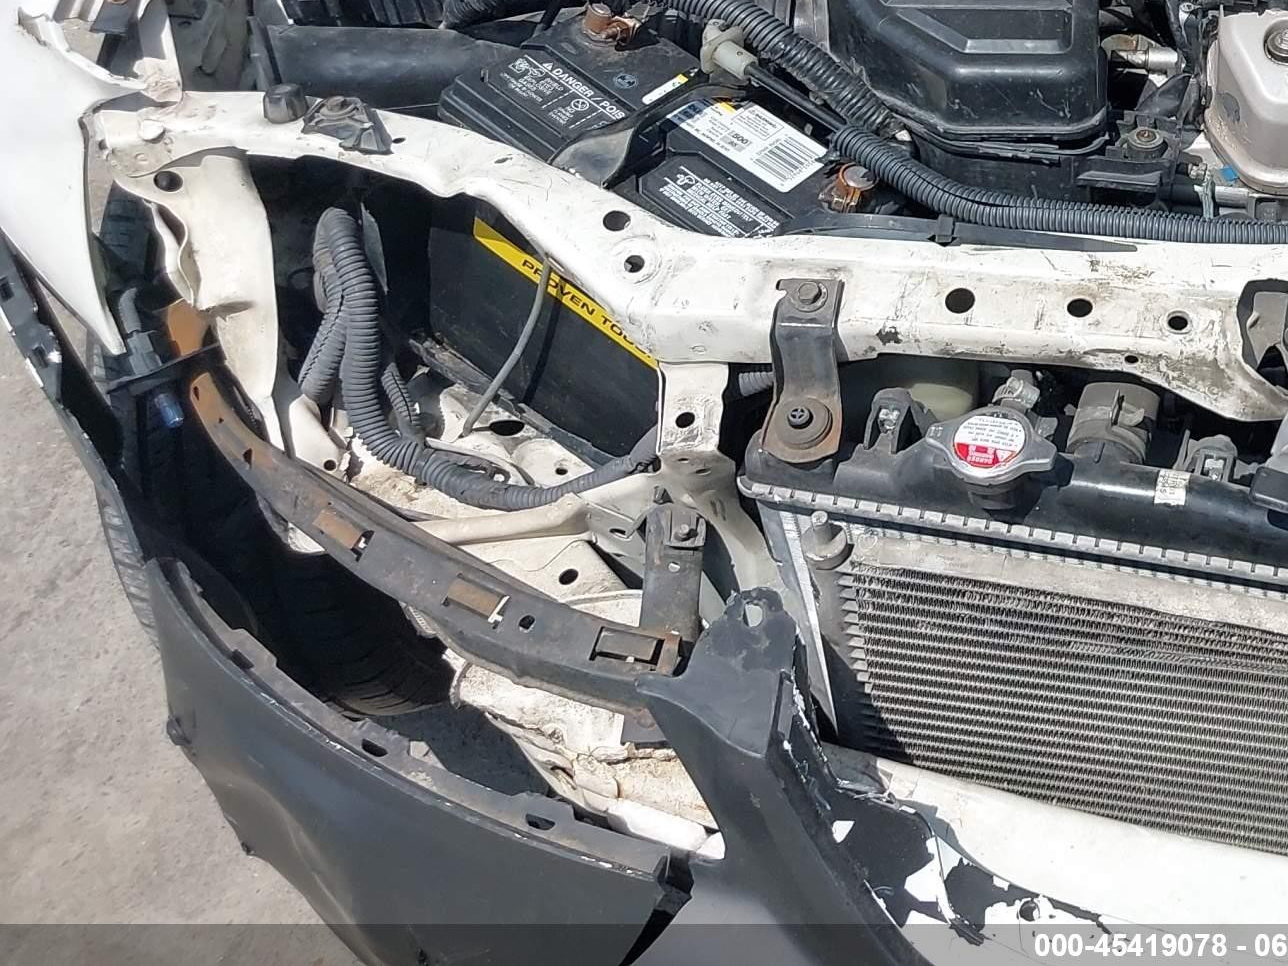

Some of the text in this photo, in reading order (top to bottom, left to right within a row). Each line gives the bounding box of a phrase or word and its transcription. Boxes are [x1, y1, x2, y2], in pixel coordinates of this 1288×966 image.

[552, 68, 594, 101] DANGER
[731, 132, 748, 144] 500
[521, 259, 595, 316] PROVEN
